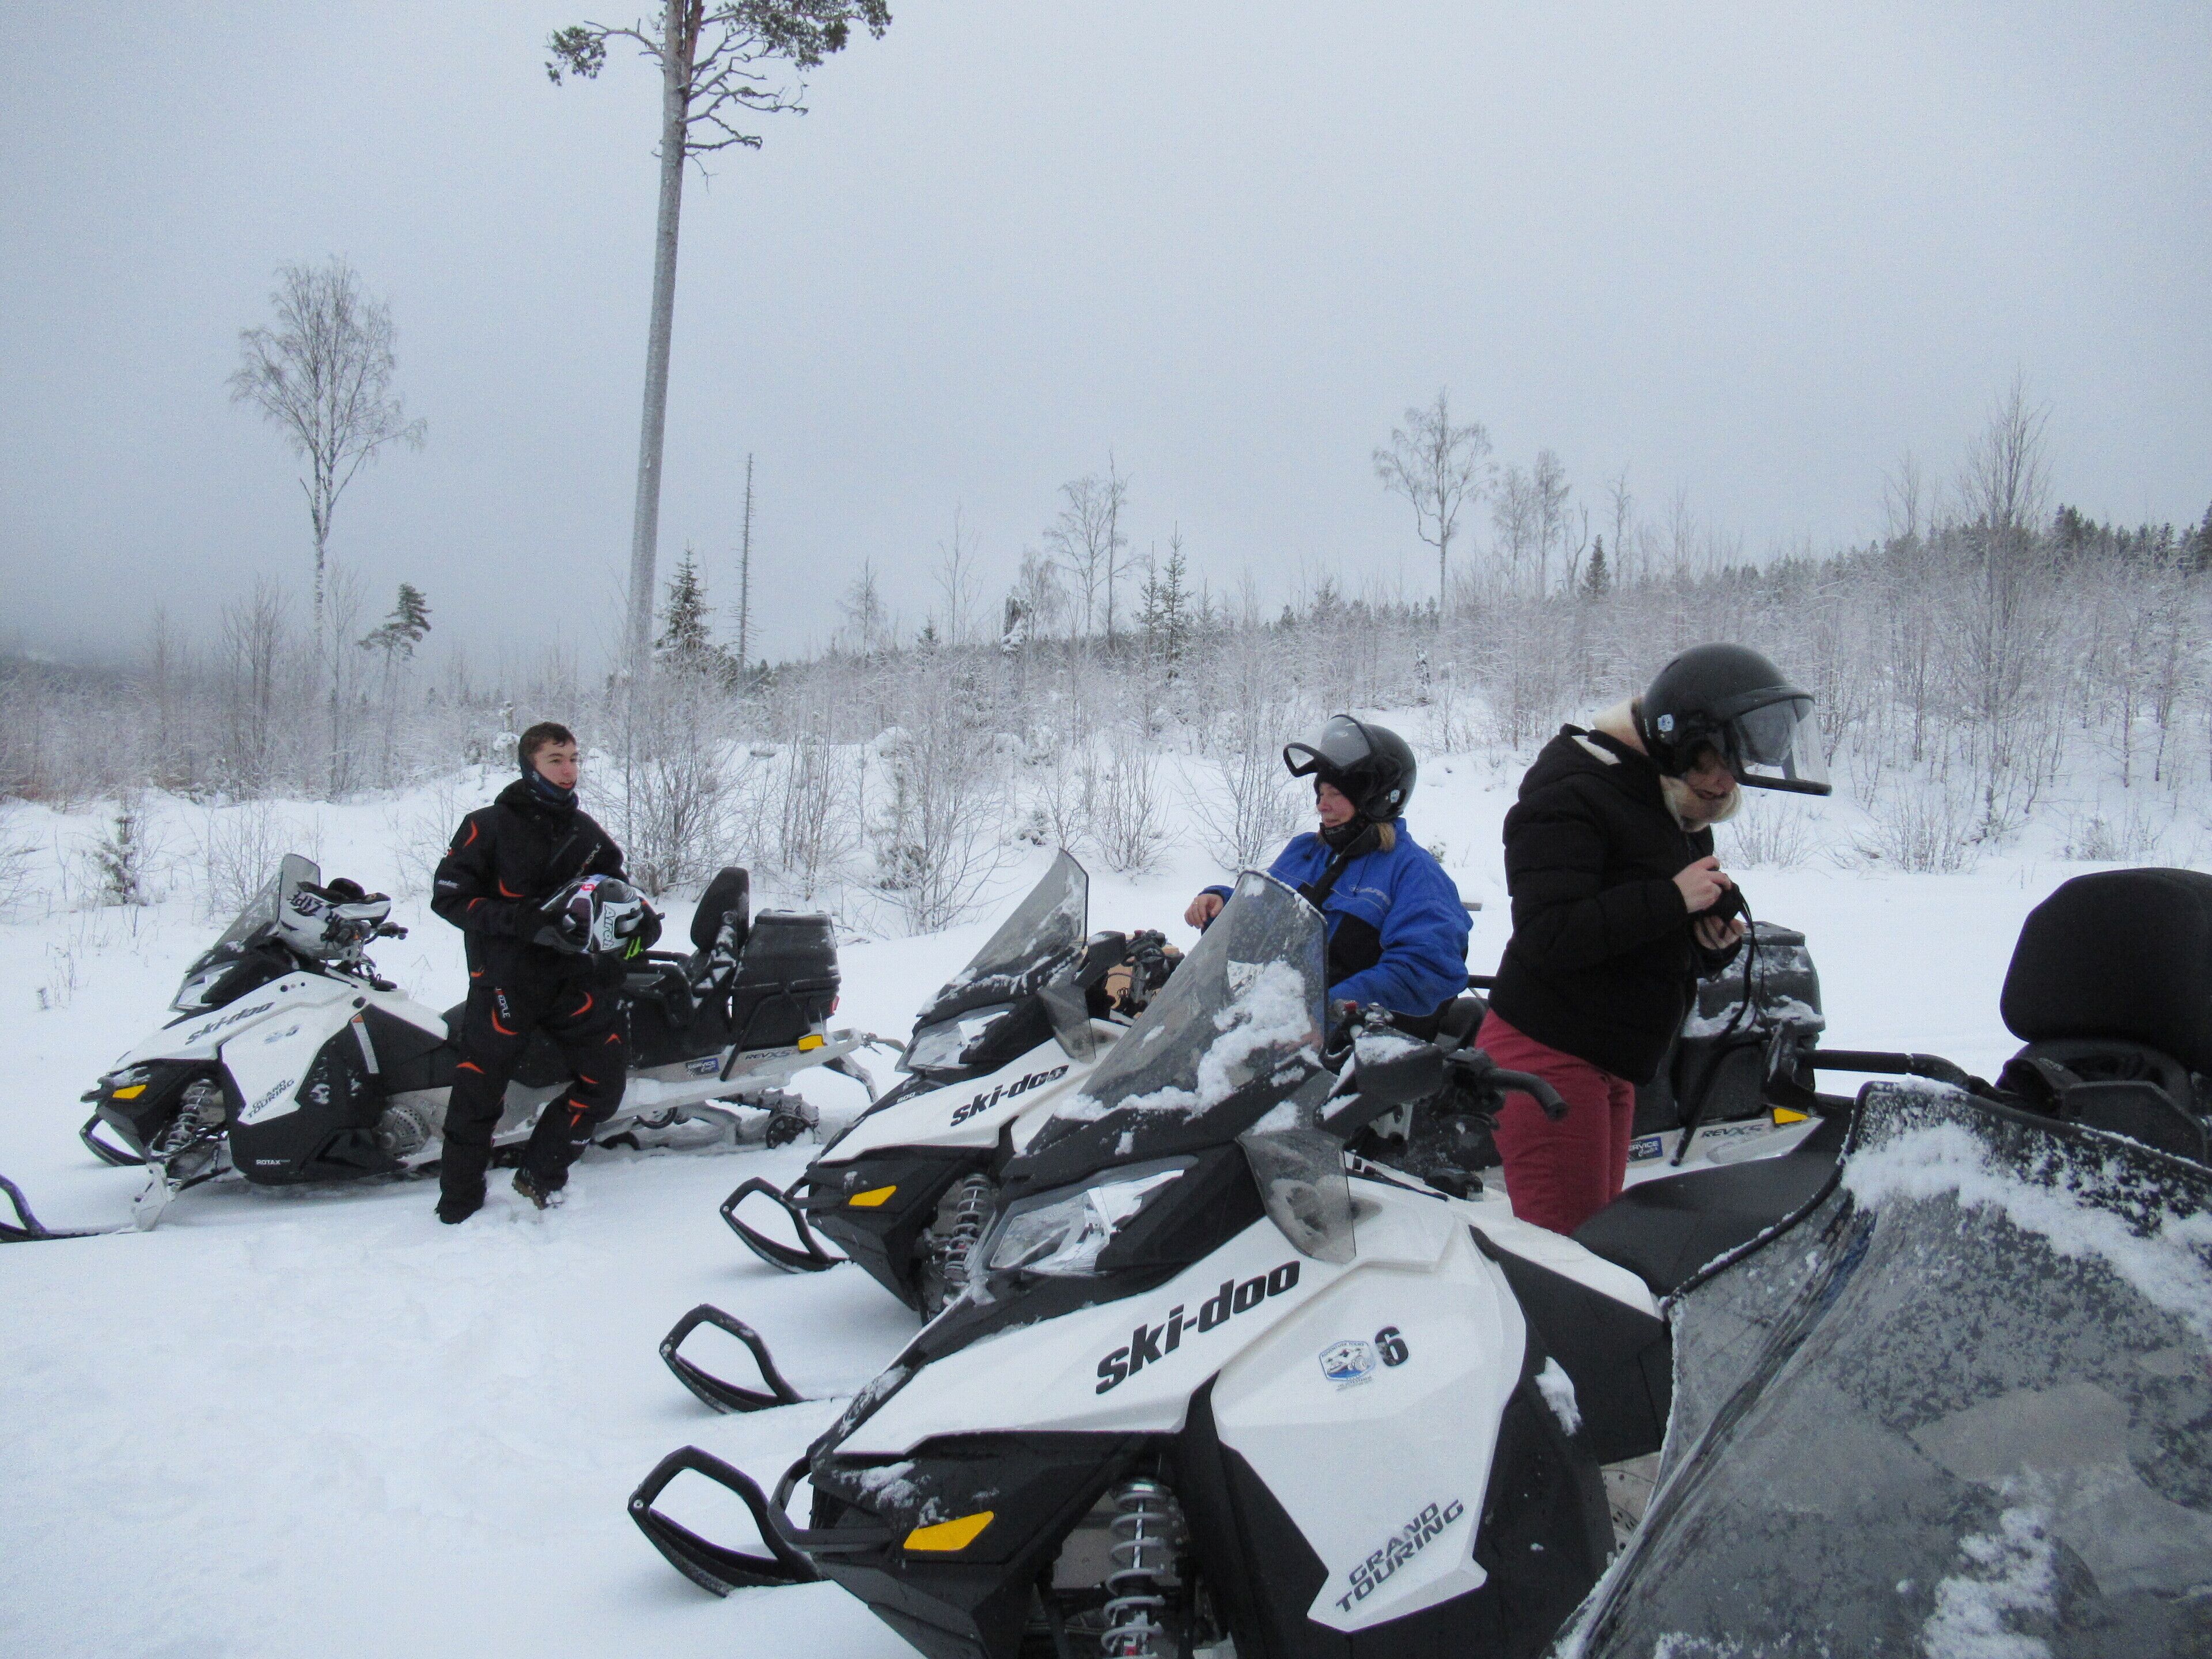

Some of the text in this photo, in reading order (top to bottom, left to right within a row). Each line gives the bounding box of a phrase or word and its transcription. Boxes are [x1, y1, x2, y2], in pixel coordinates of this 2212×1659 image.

[247, 1079, 295, 1119] TOURING
[950, 1065, 1070, 1127] ski-doo
[1628, 1140, 1658, 1152] ERVICE
[1096, 1260, 1301, 1394] ski-doo
[1375, 1325, 1409, 1366] 6
[1336, 1499, 1464, 1612] TOURING
[1349, 1502, 1439, 1586] GRAND
